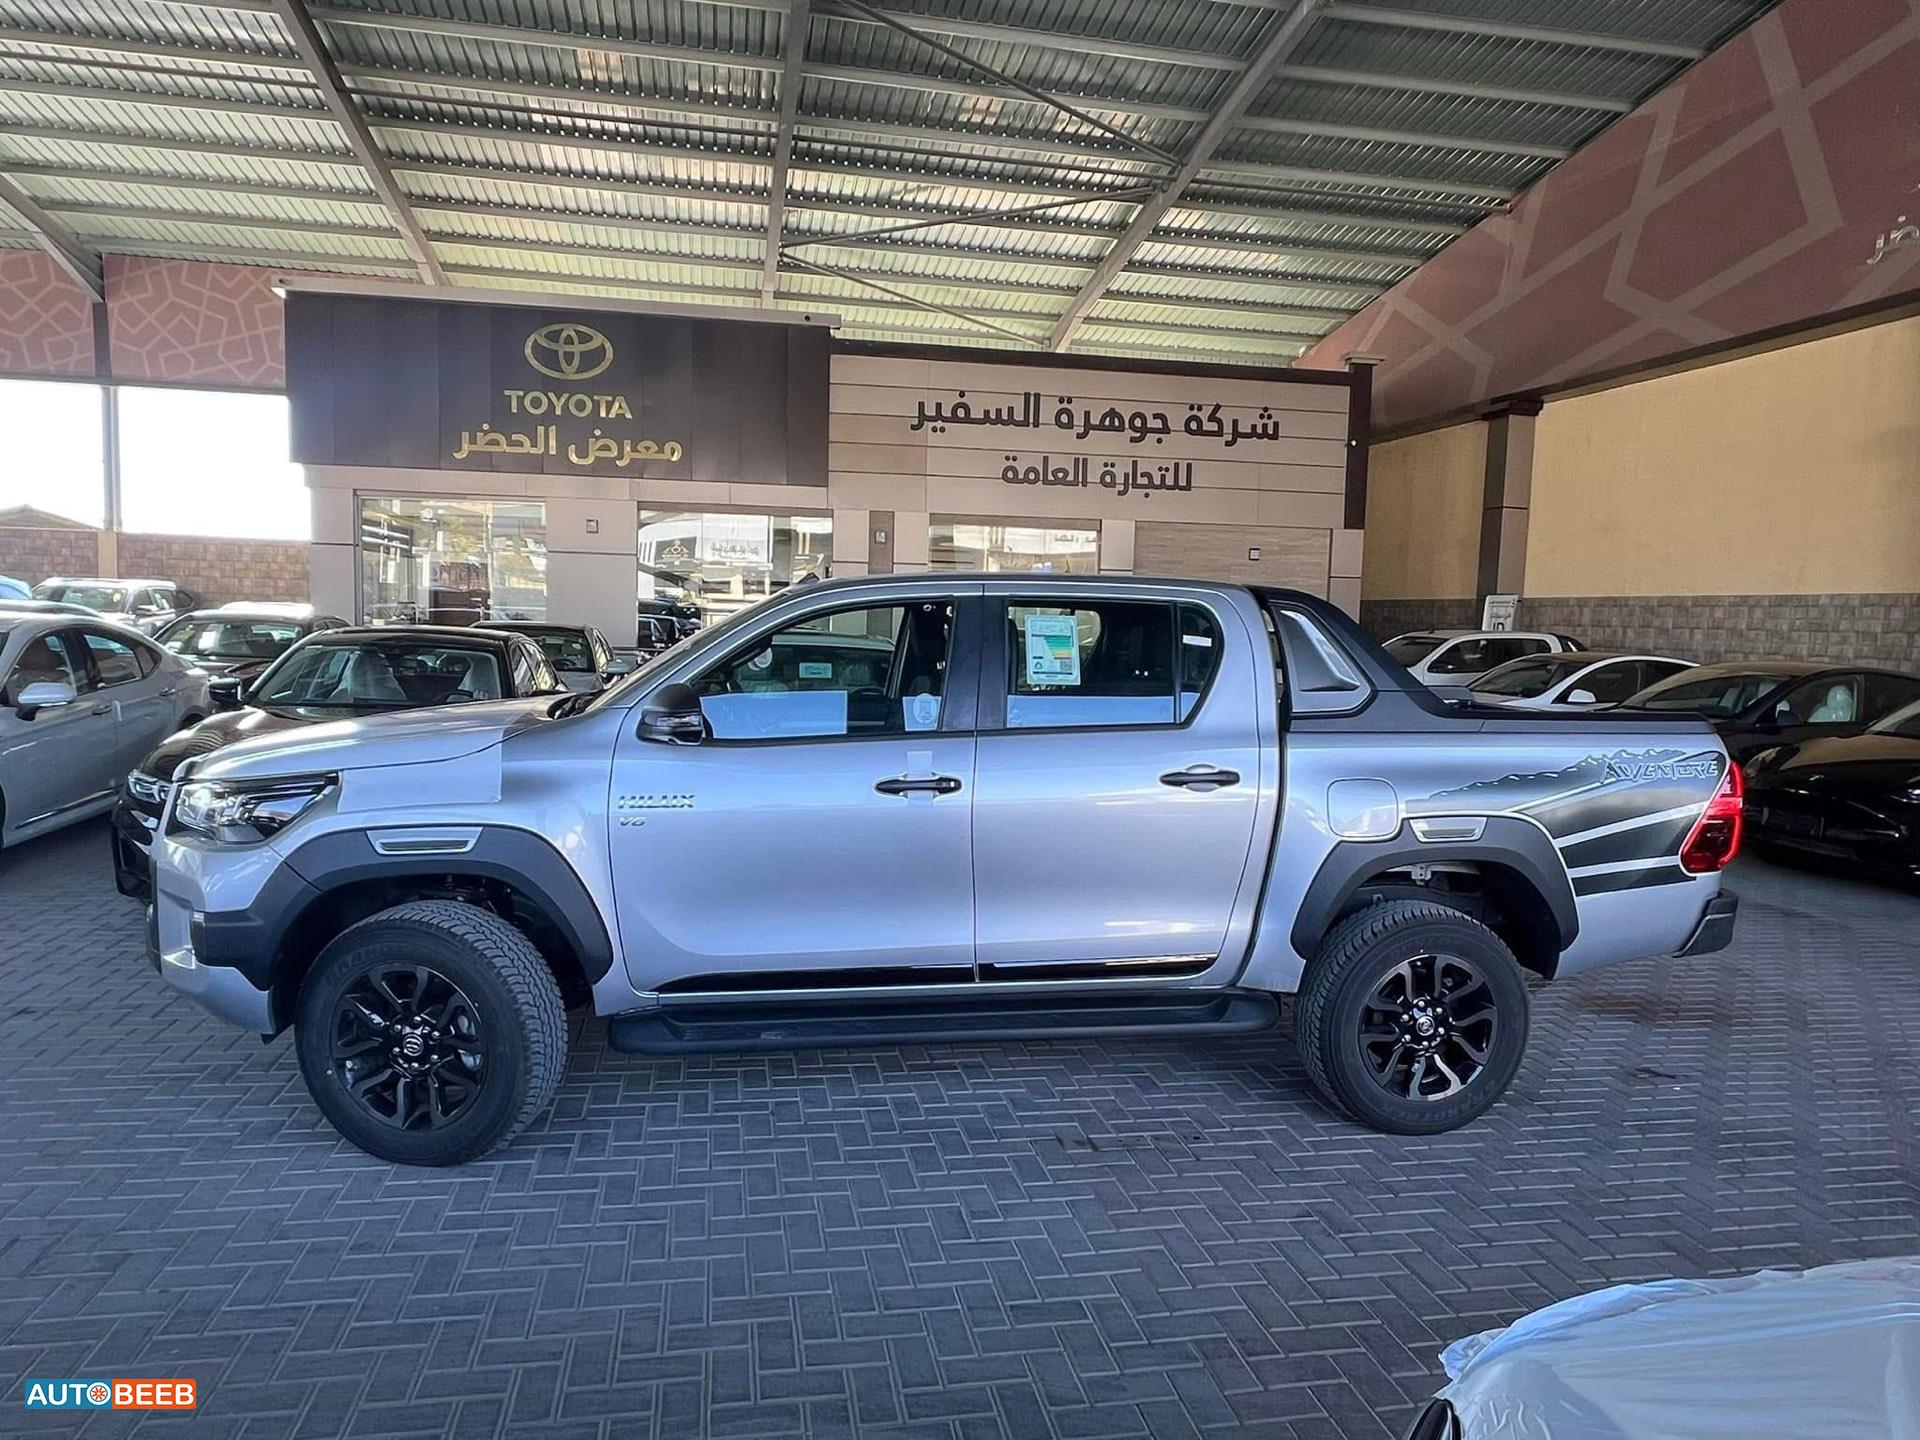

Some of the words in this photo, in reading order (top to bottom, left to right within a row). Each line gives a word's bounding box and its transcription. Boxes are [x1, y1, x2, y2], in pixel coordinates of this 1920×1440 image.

[503, 389, 633, 420] TOYOTA
[910, 389, 1042, 434] السفير
[1054, 395, 1172, 445] جوهرة
[452, 422, 558, 460] الحضر
[1184, 402, 1280, 448] شركة
[567, 427, 683, 468] معرض
[1001, 454, 1089, 488] العامة
[1099, 459, 1193, 499] للتجارة
[617, 794, 697, 809] HILUX
